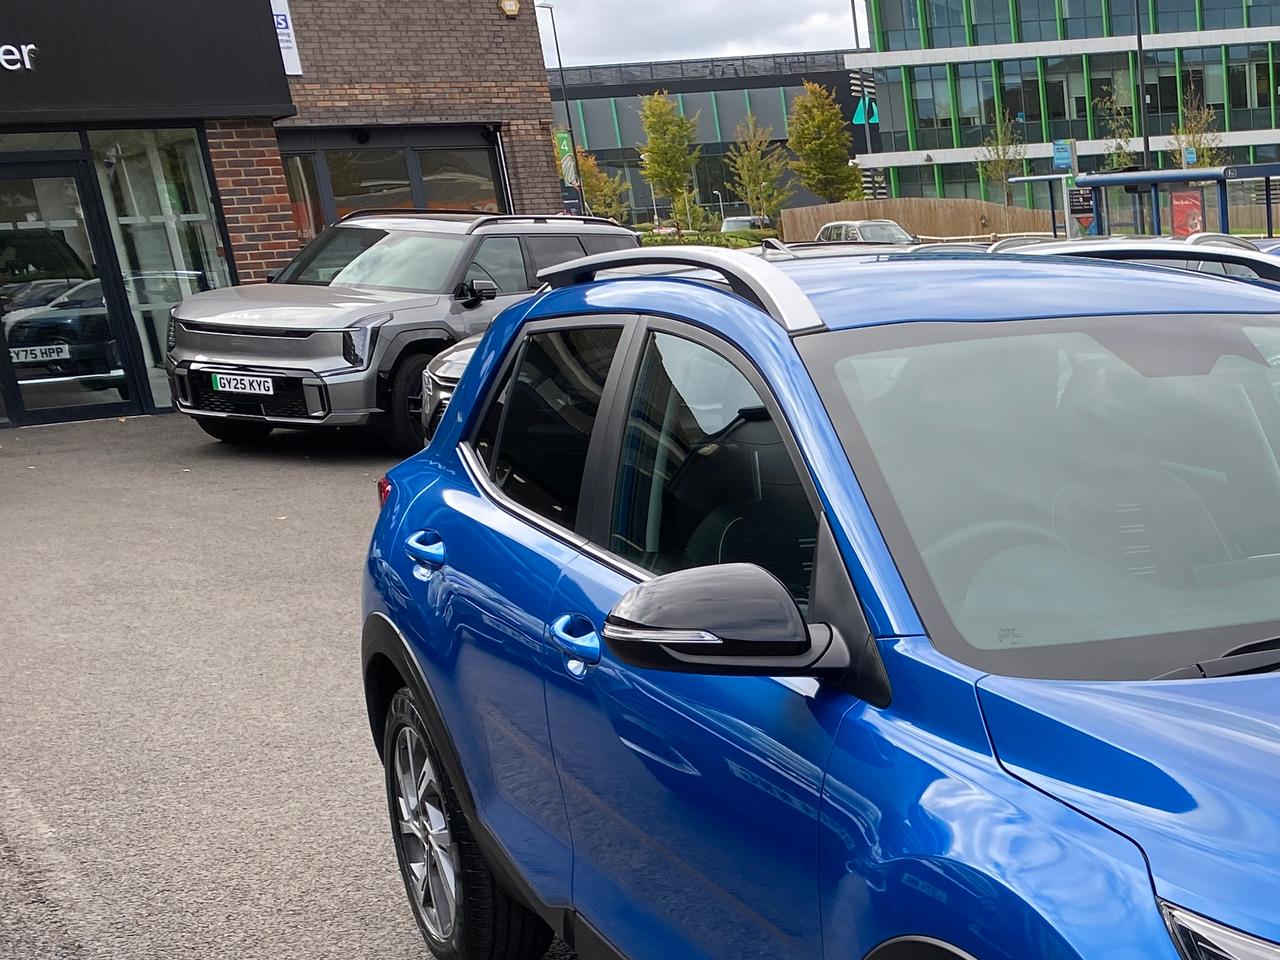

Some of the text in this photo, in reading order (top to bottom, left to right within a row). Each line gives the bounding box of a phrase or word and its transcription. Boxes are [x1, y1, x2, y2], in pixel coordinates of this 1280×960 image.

[561, 140, 569, 152] 4
[40, 347, 63, 358] HPP
[219, 376, 271, 392] GY25 KYG
